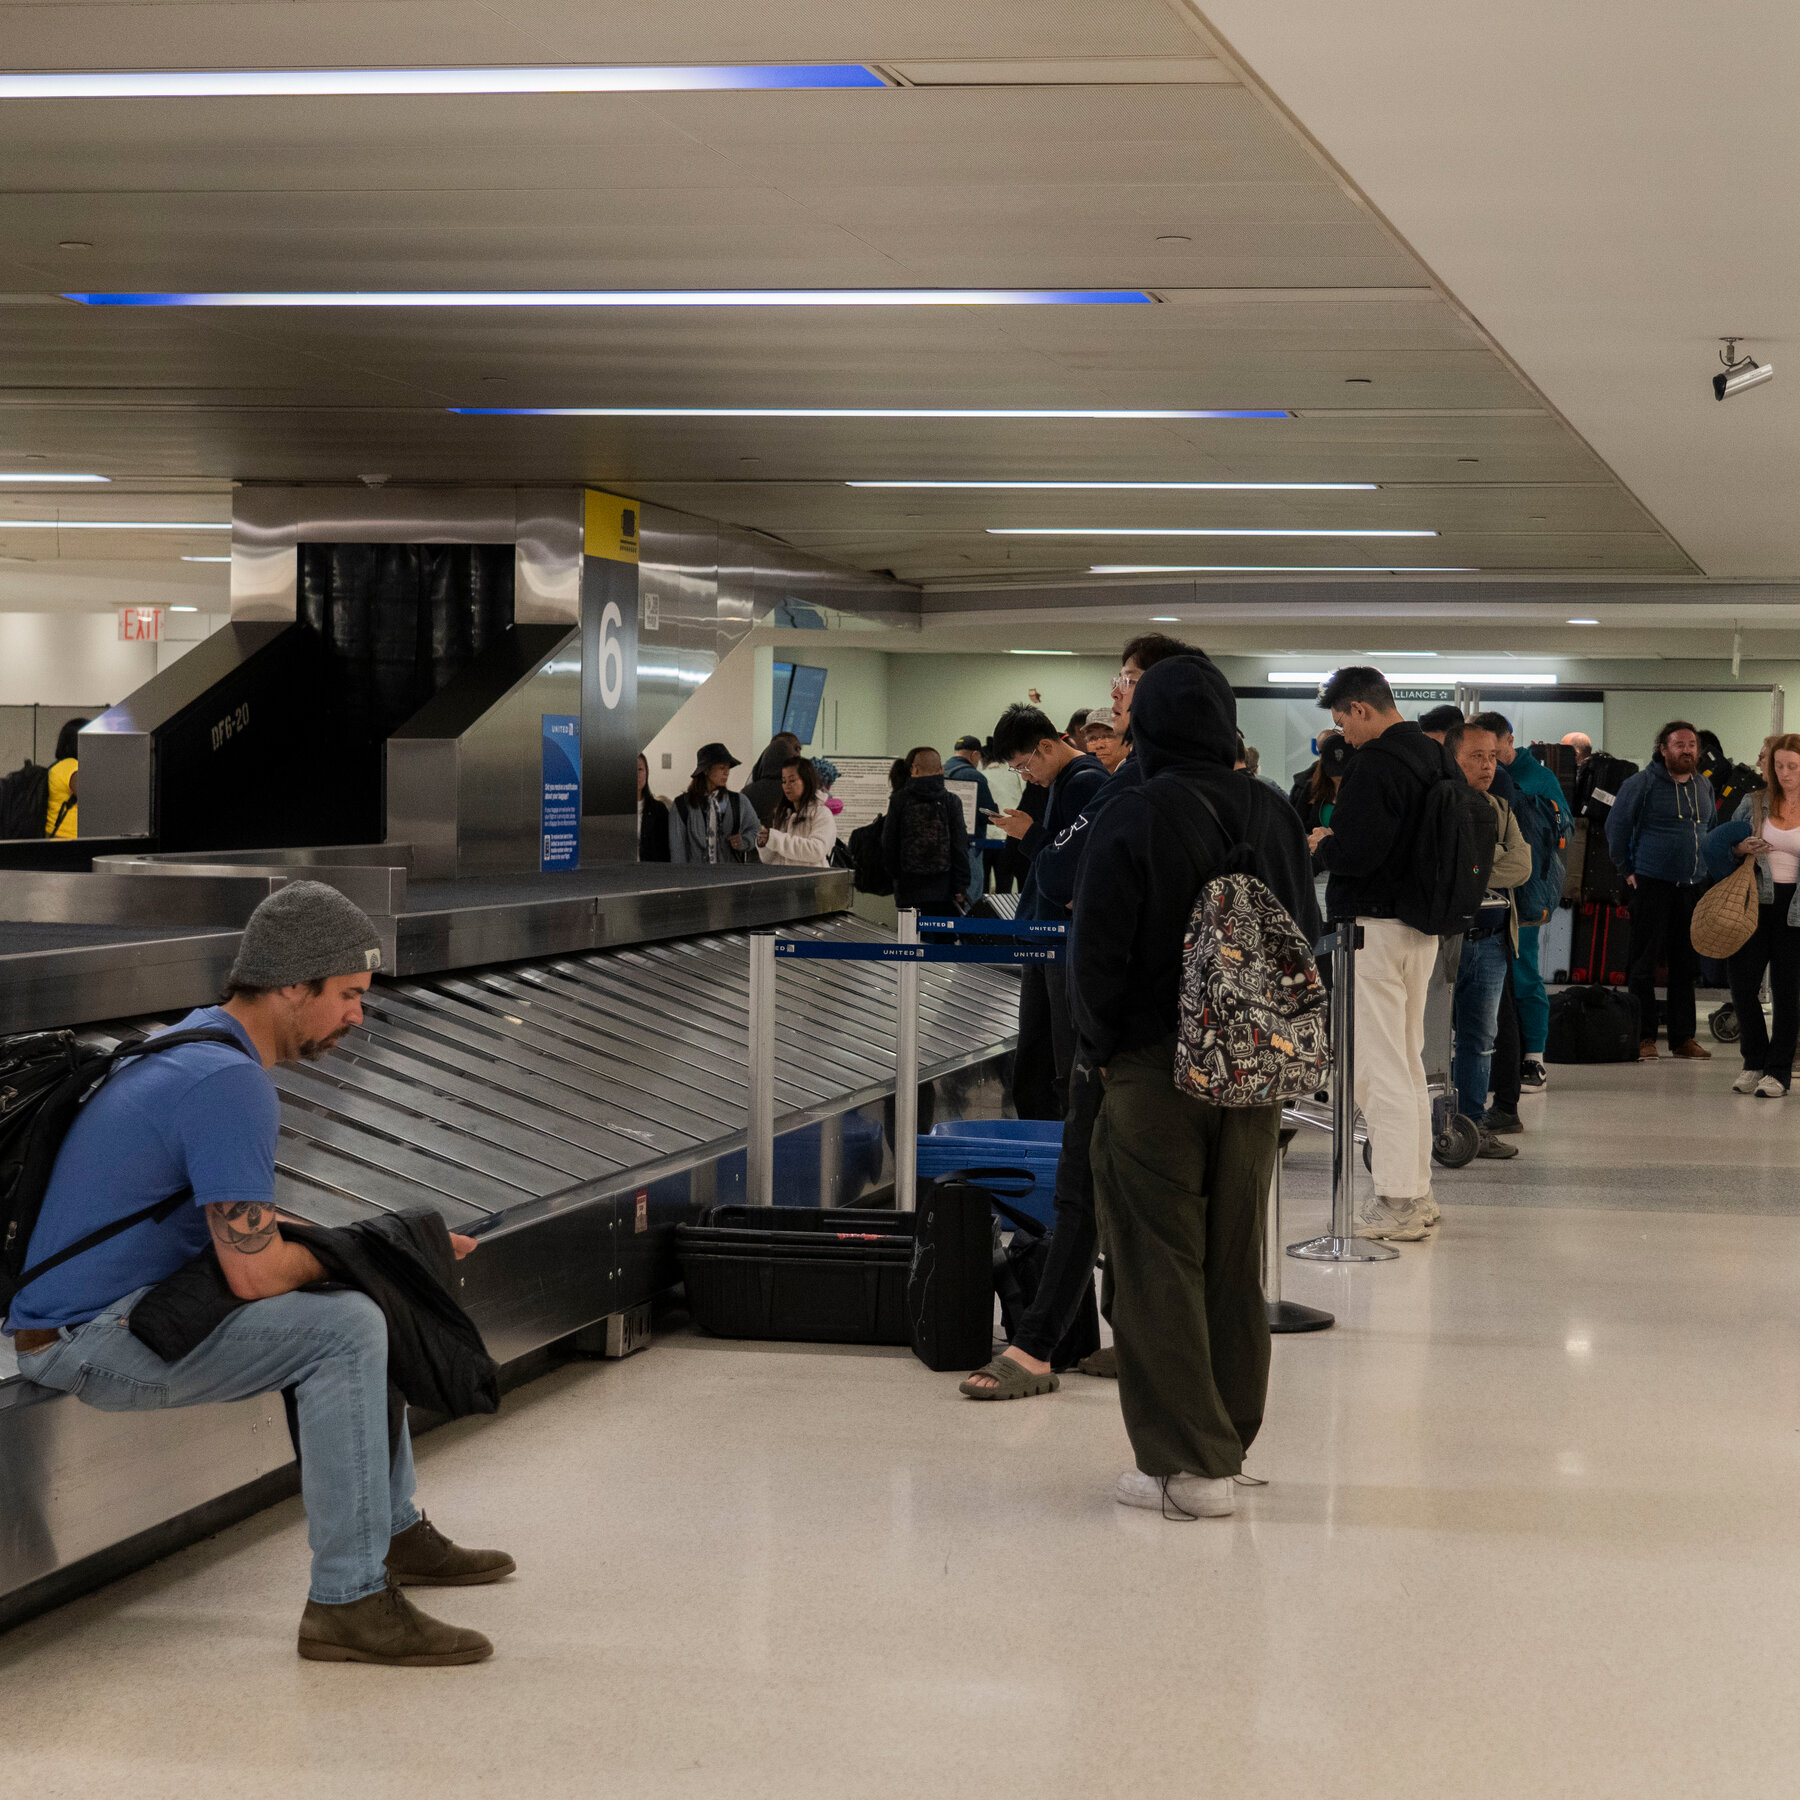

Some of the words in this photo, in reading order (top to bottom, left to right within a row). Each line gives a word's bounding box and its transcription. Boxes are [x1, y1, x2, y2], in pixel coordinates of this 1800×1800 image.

[124, 609, 161, 641] EXIT
[599, 601, 622, 710] 6
[1395, 690, 1437, 699] LLIANCE
[211, 702, 250, 751] DF6-20
